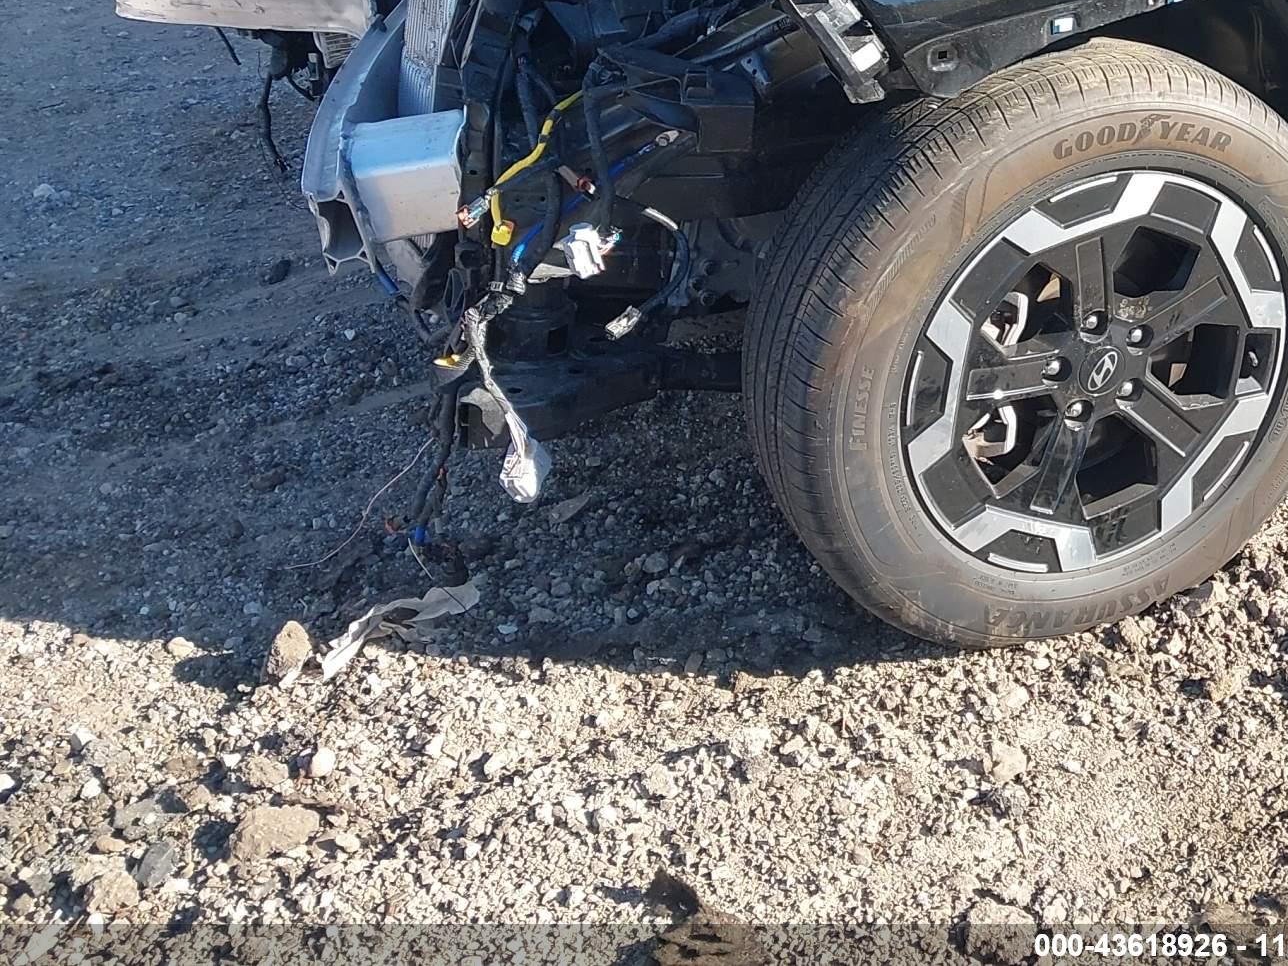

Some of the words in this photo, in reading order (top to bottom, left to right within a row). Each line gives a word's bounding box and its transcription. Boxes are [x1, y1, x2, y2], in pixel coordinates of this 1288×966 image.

[1053, 114, 1232, 160] GOODYEAR
[849, 365, 875, 451] FINESSE
[983, 574, 1170, 630] ASSURANCE
